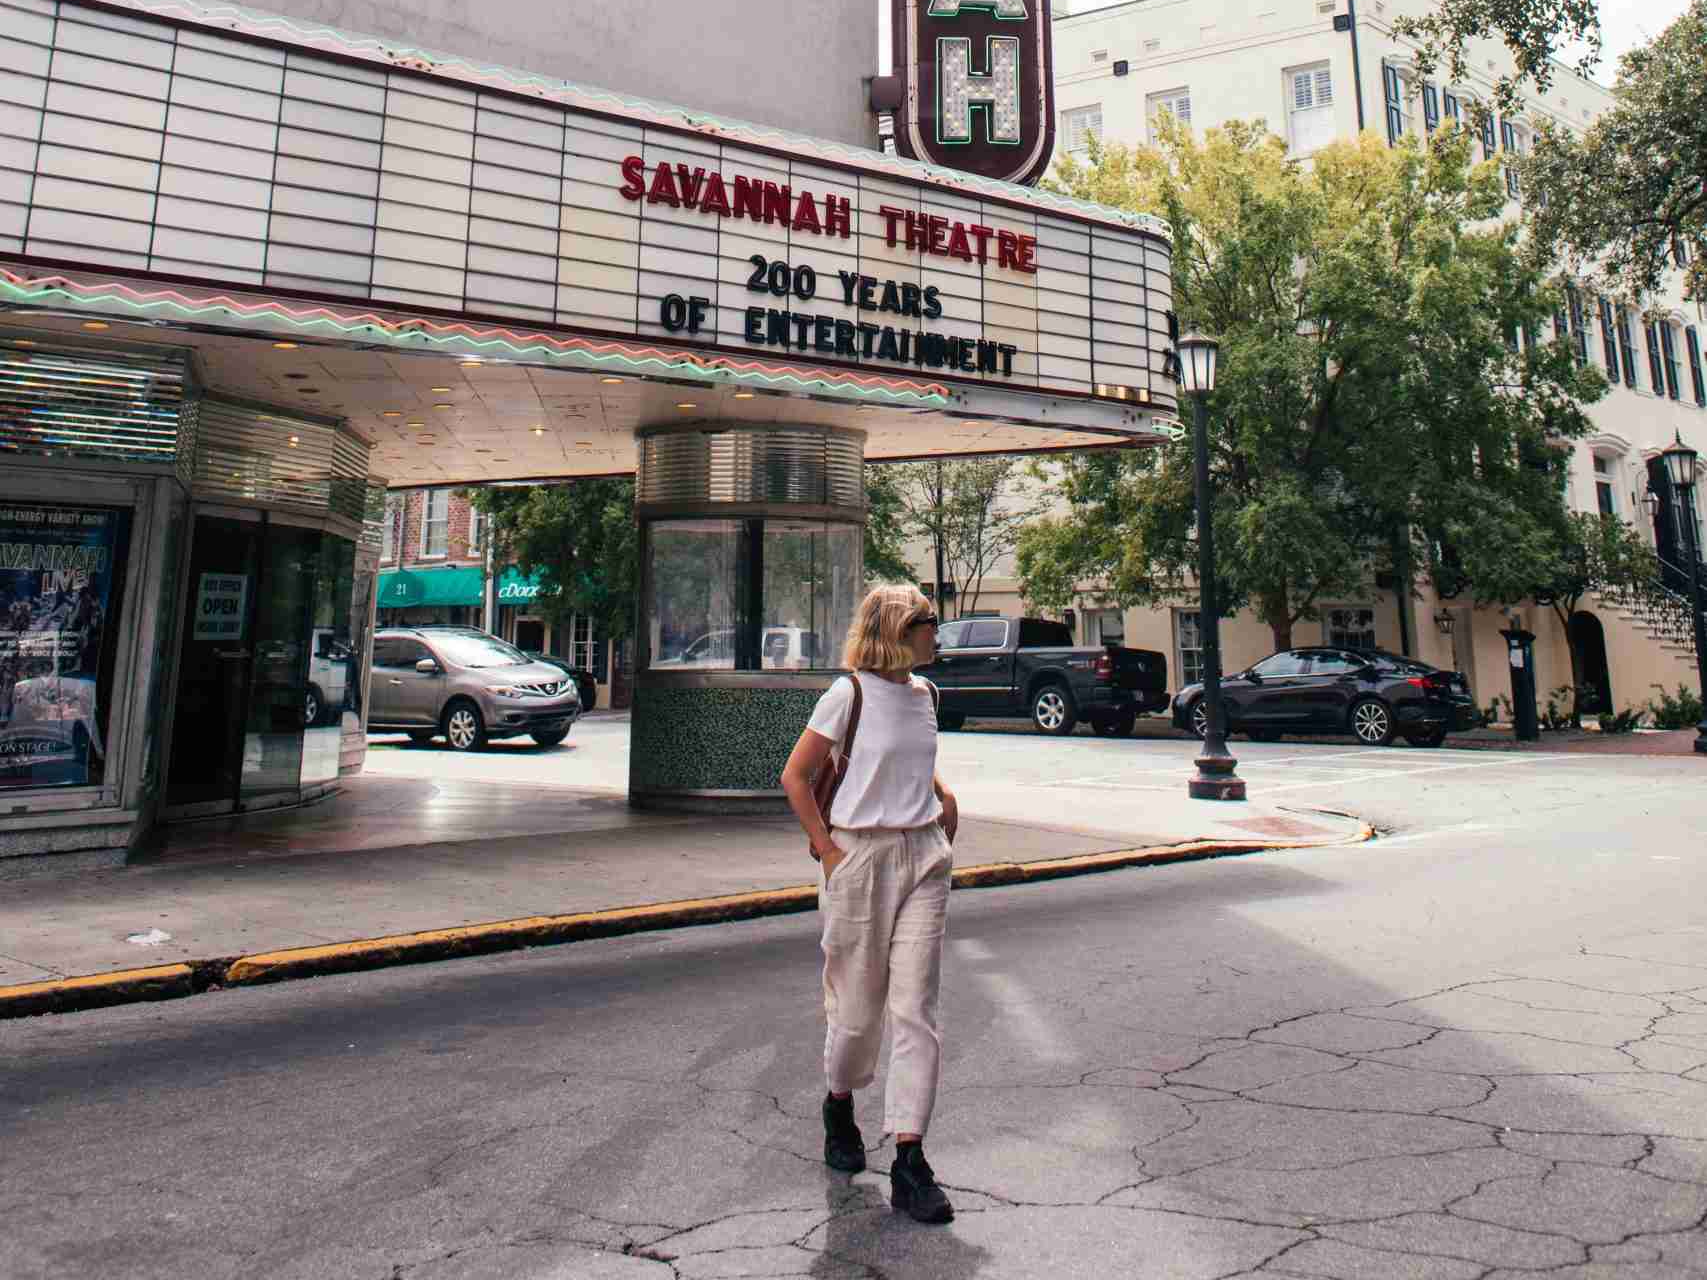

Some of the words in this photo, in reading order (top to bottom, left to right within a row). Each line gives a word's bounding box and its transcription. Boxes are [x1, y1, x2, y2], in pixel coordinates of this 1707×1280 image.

[619, 155, 851, 239] SAVANNAH
[879, 204, 1038, 274] THEATRE
[746, 254, 816, 300] 200
[838, 269, 943, 320] YEARS
[660, 293, 710, 333] OF
[744, 306, 1017, 377] ENTERTAINMENT
[203, 598, 239, 617] OPEN
[395, 583, 407, 596] 21
